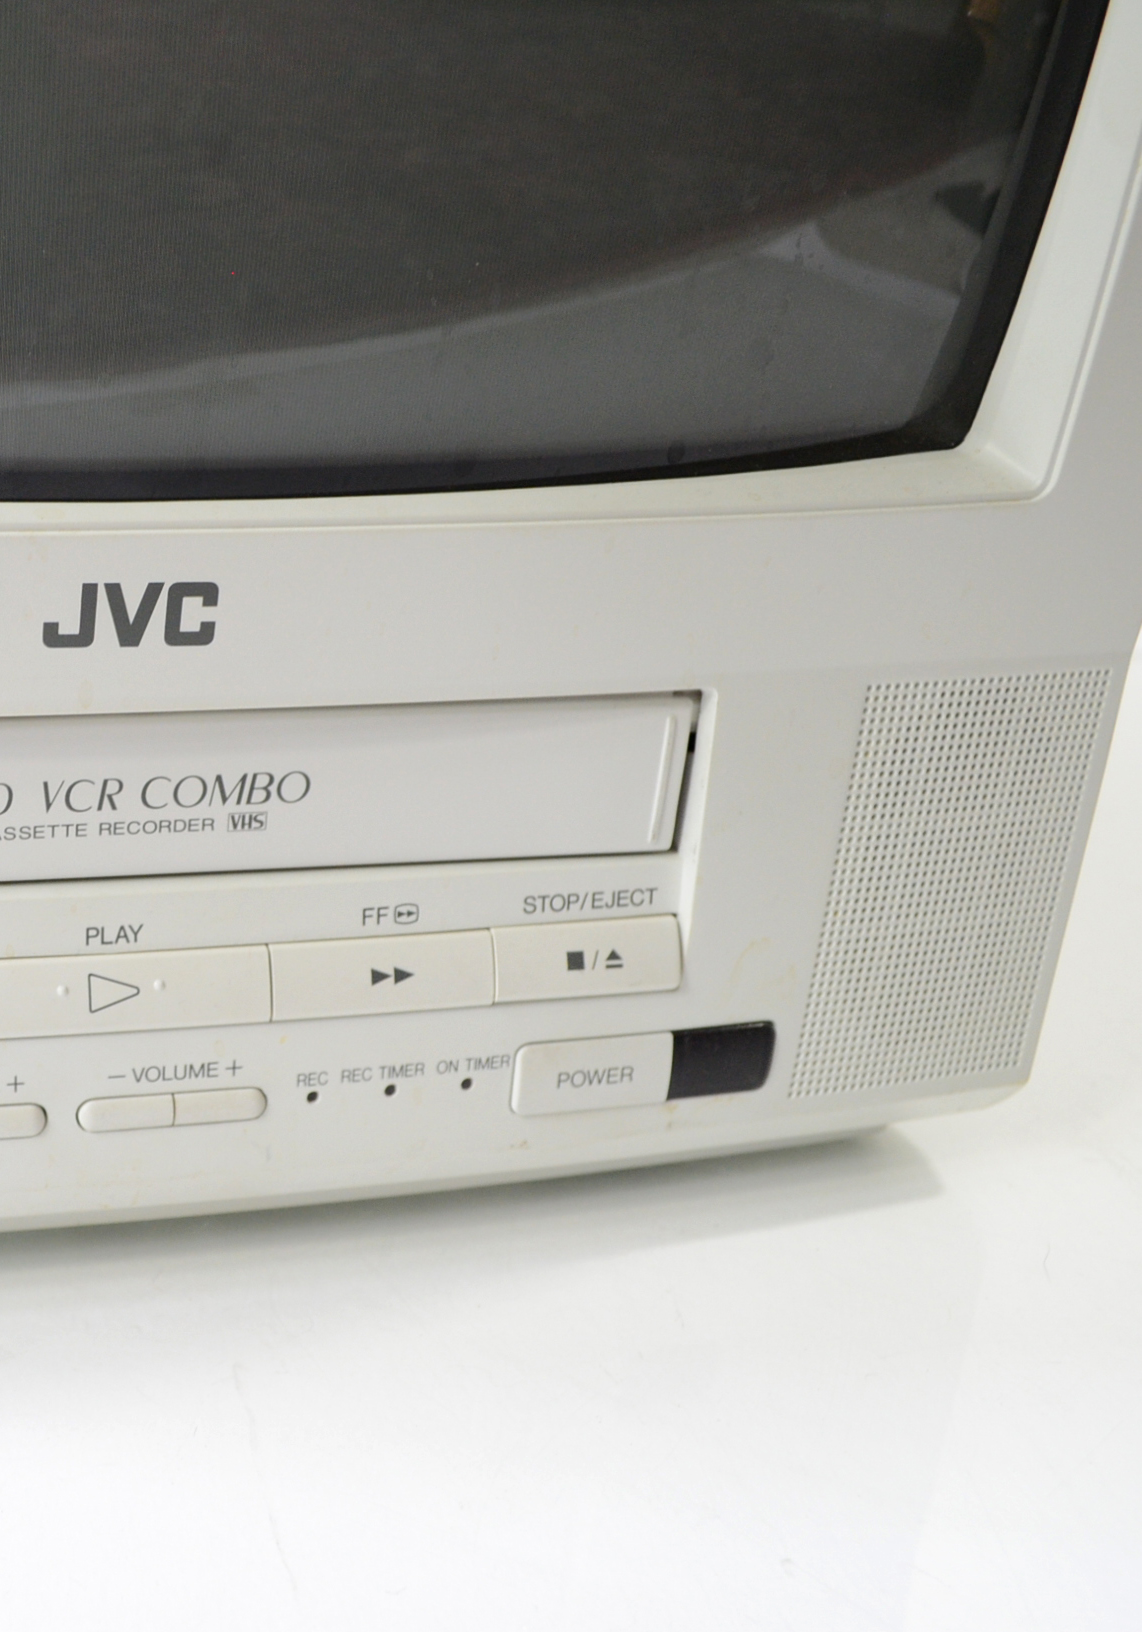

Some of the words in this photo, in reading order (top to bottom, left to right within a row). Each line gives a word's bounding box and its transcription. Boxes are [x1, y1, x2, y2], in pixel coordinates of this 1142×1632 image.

[42, 581, 220, 649] JVC
[42, 778, 124, 813] VCR
[140, 770, 312, 810] COMBO
[98, 817, 216, 837] RECORDER
[230, 813, 265, 831] VHS
[522, 886, 659, 915] STOP/EJECT
[361, 905, 390, 927] FF
[85, 923, 144, 947] PLAY
[131, 1061, 219, 1084] VOLUME
[340, 1066, 373, 1084] REC
[379, 1062, 426, 1080] TIMER
[435, 1059, 460, 1075] ON
[465, 1053, 511, 1071] TIMER
[295, 1070, 329, 1088] REC
[556, 1065, 635, 1089] POWER
